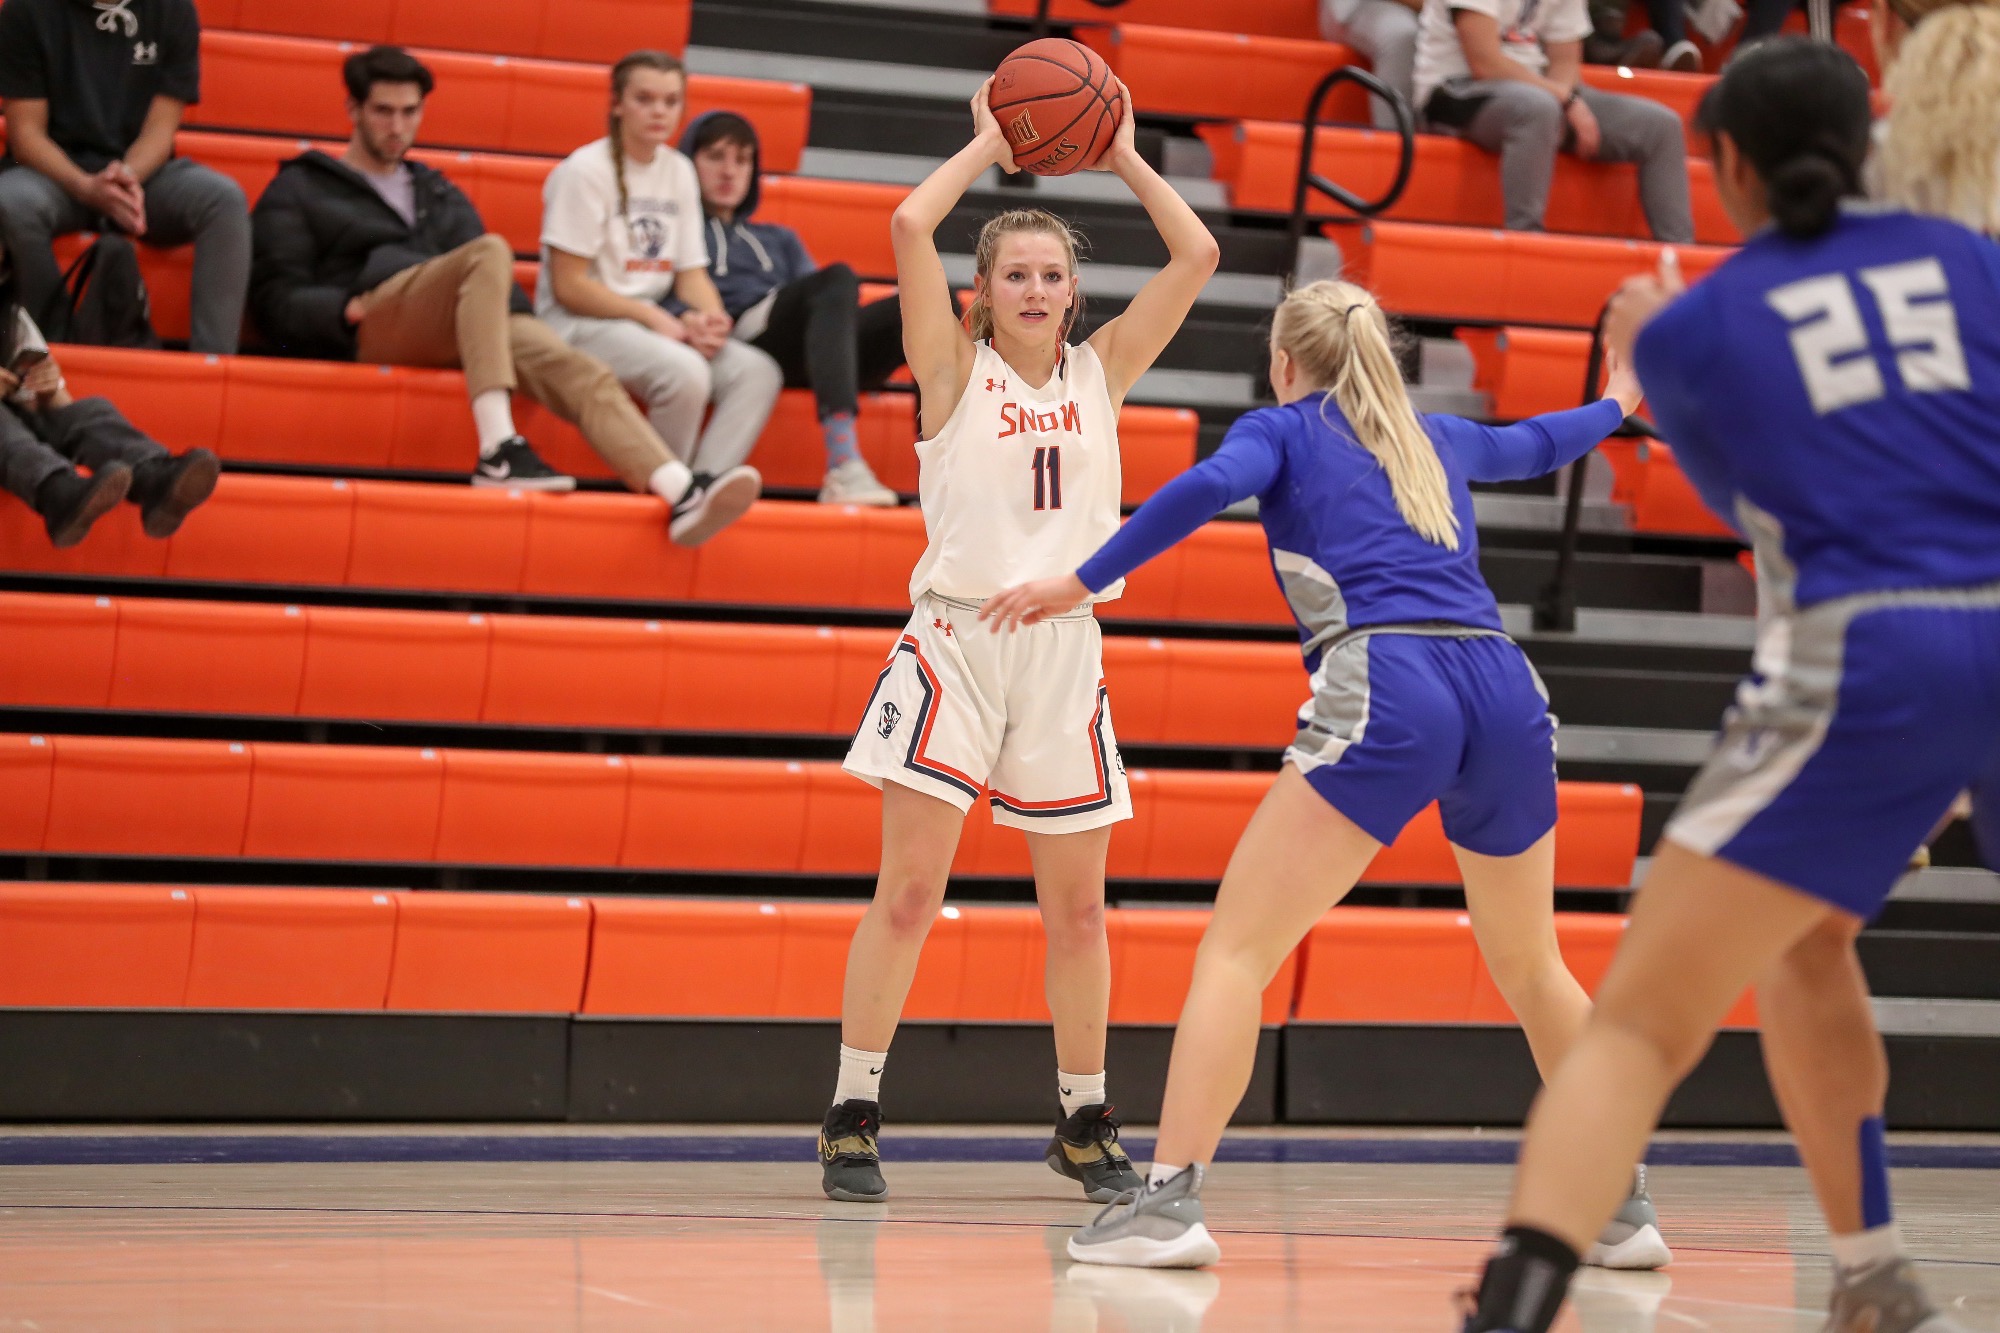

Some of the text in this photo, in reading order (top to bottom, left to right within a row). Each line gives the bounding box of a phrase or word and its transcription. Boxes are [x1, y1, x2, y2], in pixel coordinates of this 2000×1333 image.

[1765, 256, 1972, 417] 25
[998, 400, 1081, 439] SNOW
[1031, 445, 1062, 511] 11
